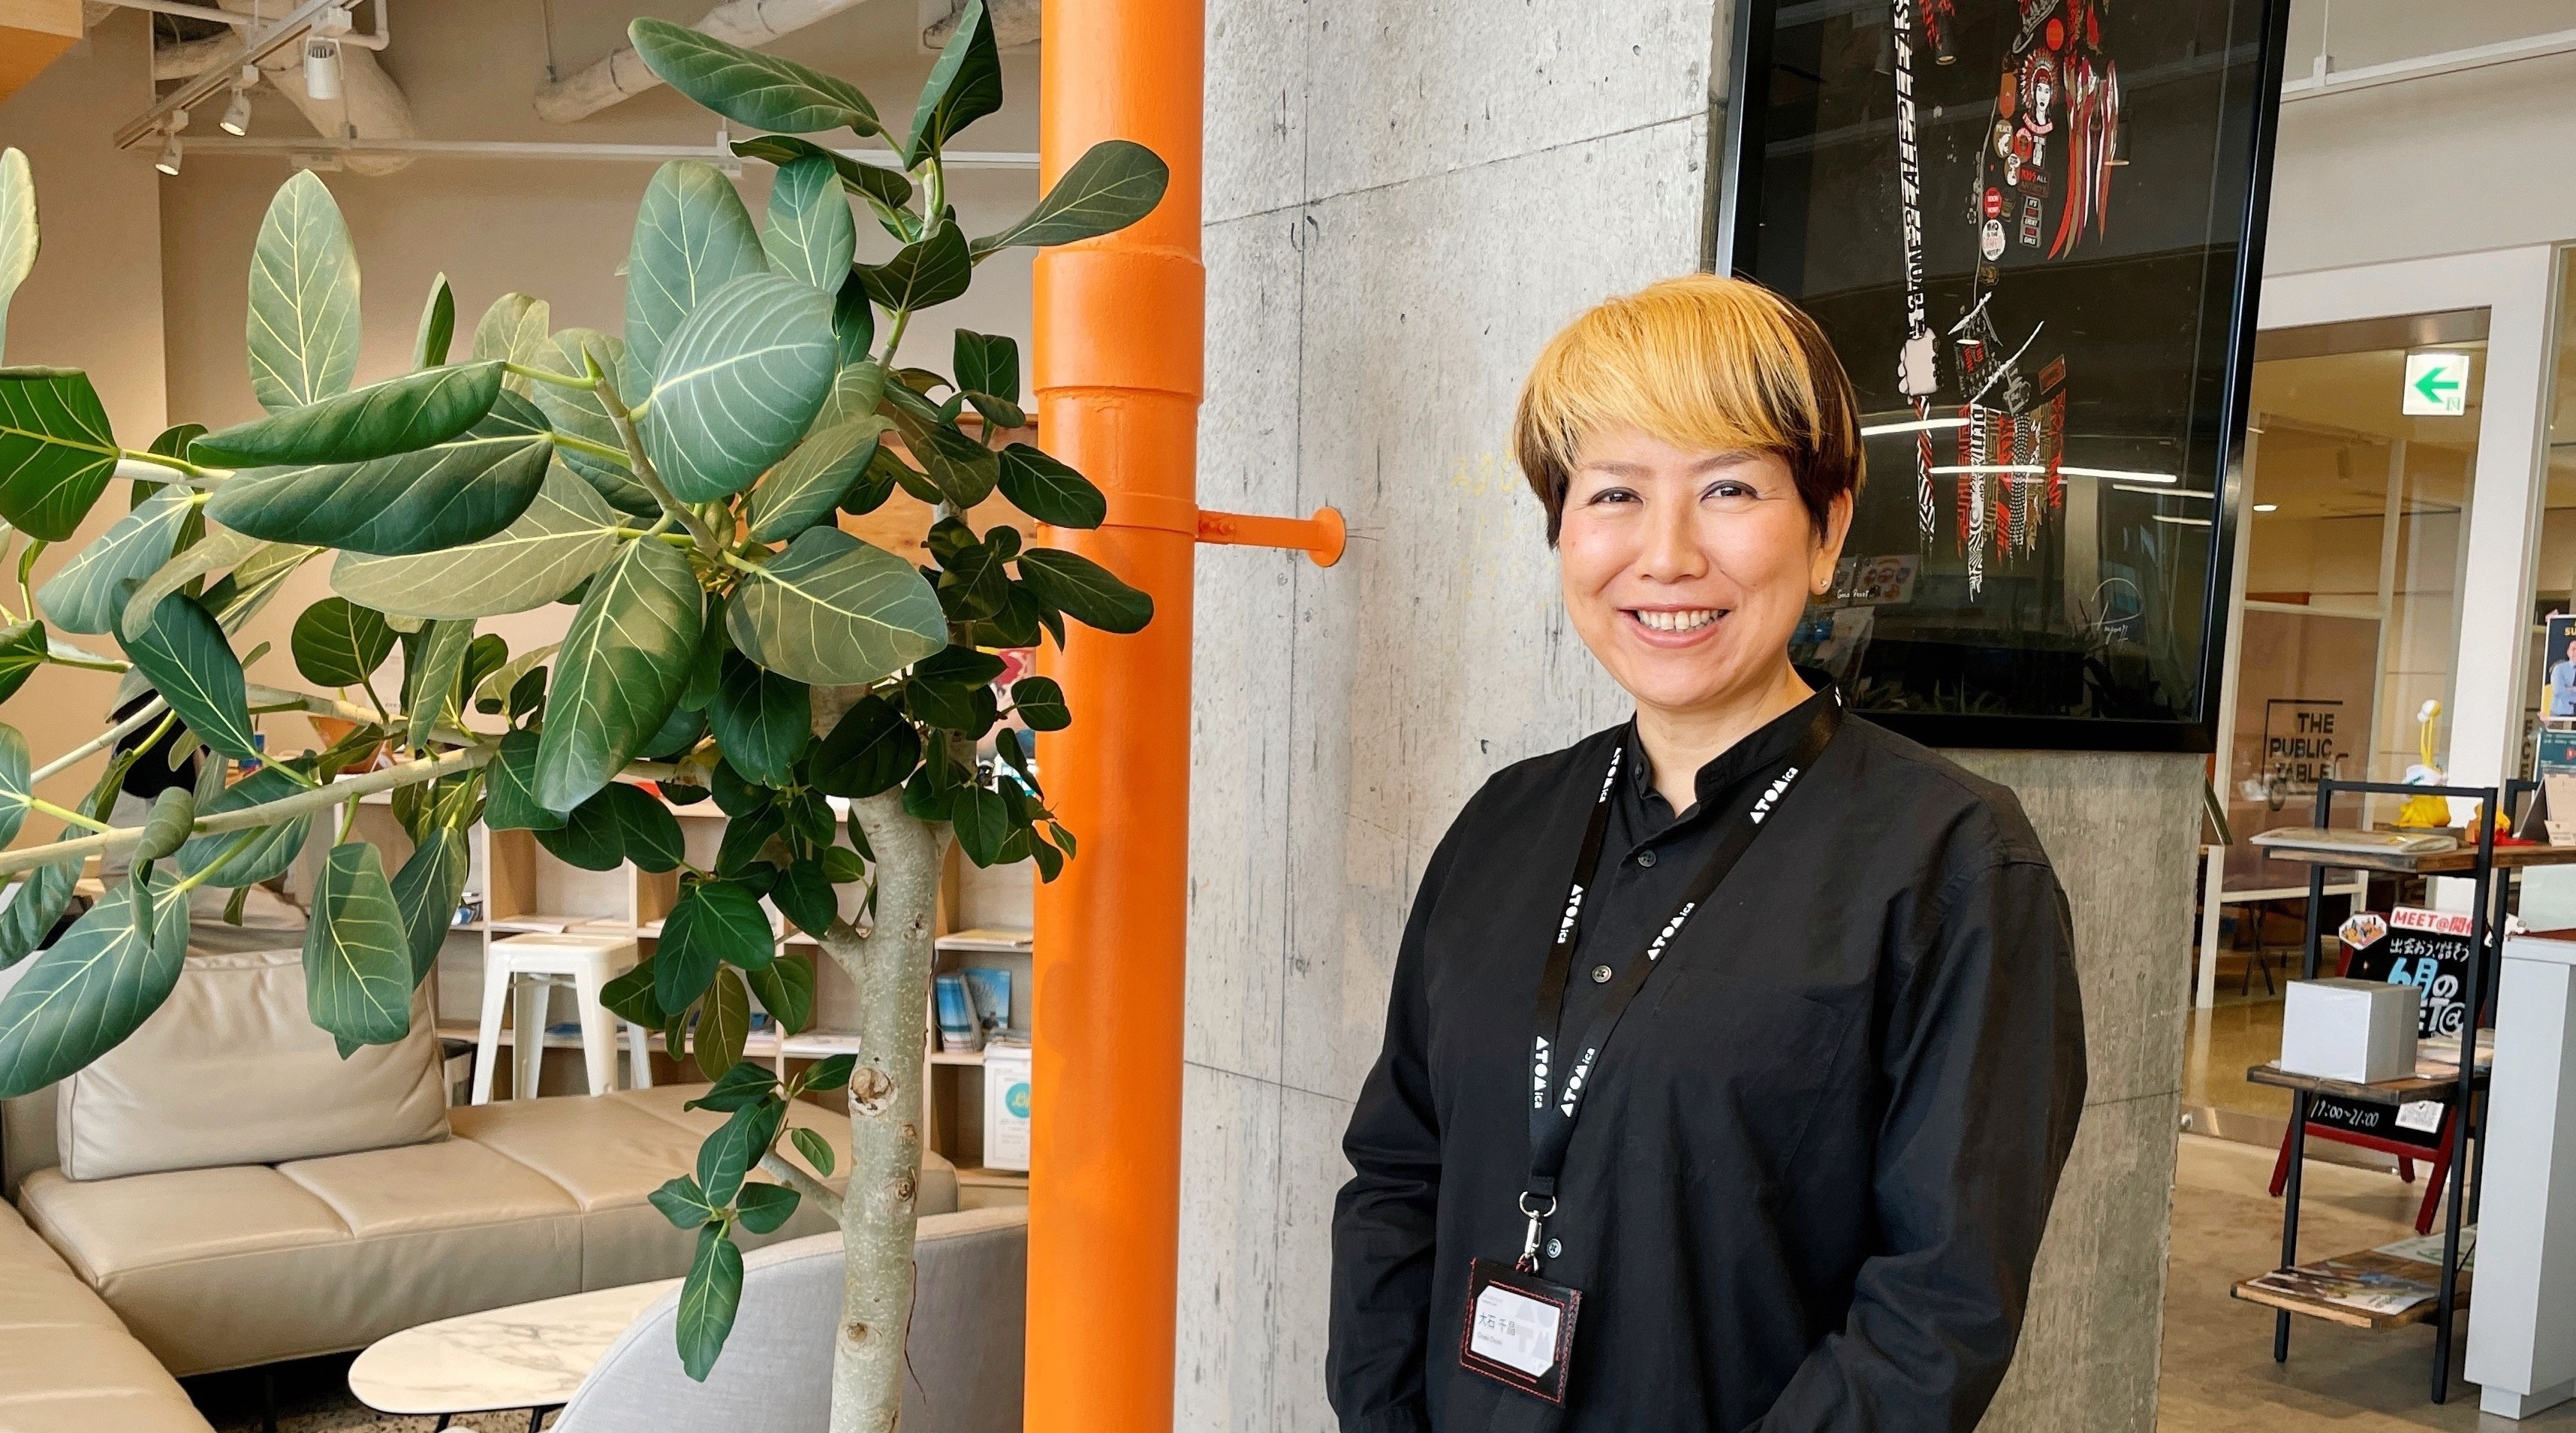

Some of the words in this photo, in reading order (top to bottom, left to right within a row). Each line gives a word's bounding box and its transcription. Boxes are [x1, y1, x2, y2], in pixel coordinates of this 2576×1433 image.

[2269, 737, 2333, 759] PUBLIC
[2297, 713, 2334, 734] THE
[1750, 767, 1798, 824] ATOMica
[2276, 763, 2330, 783] TABLE
[1557, 884, 1583, 943] ATOMica
[1647, 902, 1695, 961] ATOMica
[1534, 1036, 1550, 1109] ATOMica
[1560, 1048, 1595, 1118] ATOMica
[1478, 1312, 1496, 1330] 大石
